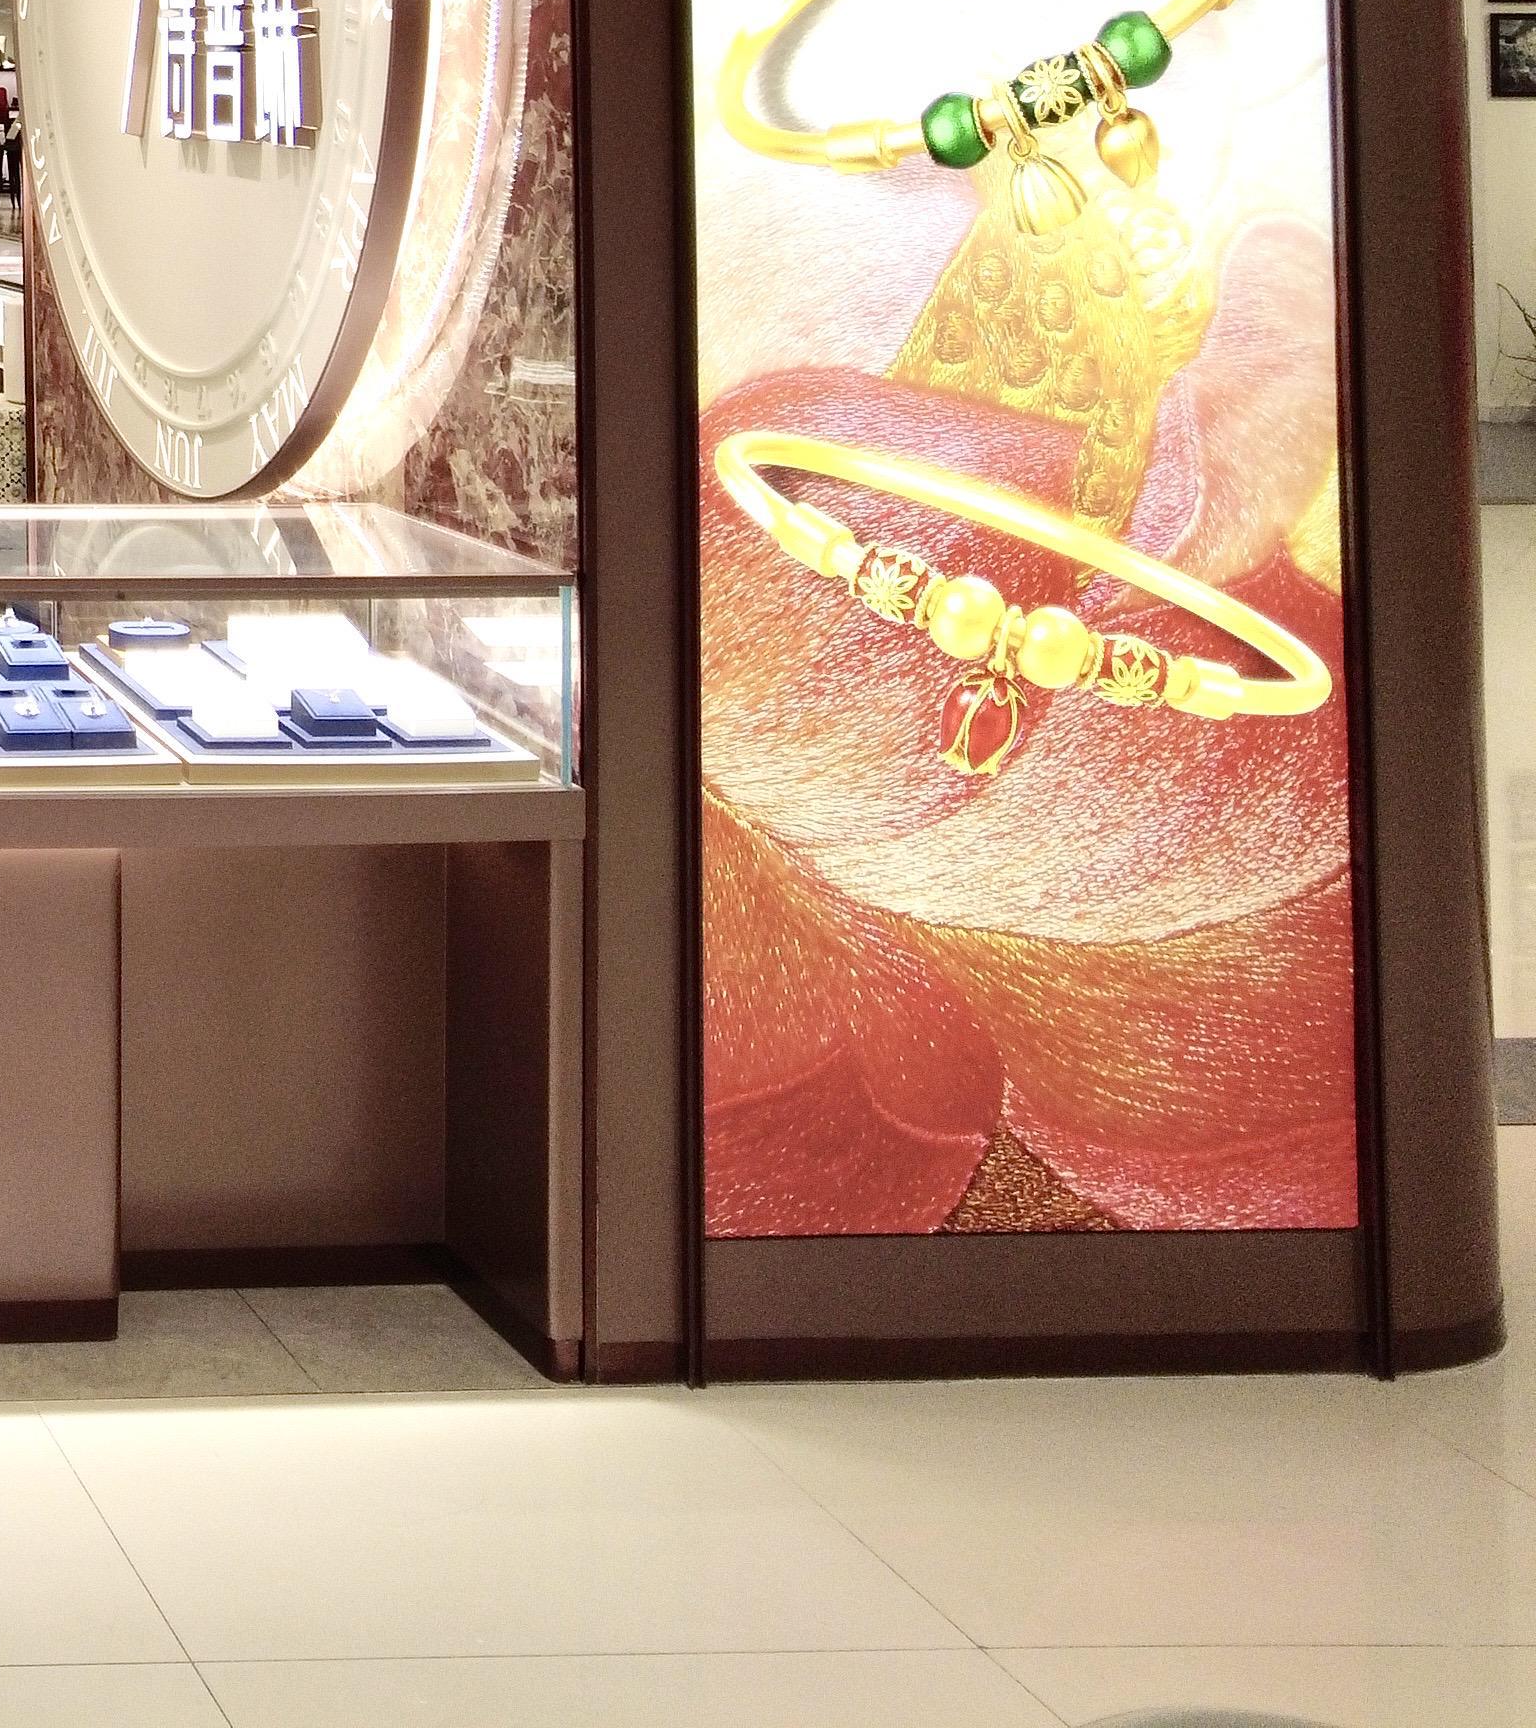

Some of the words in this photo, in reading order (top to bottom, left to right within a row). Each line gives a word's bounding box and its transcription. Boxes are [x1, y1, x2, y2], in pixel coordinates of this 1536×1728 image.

[330, 132, 377, 294] APR
[153, 418, 203, 489] JUN
[248, 352, 310, 475] MAY
